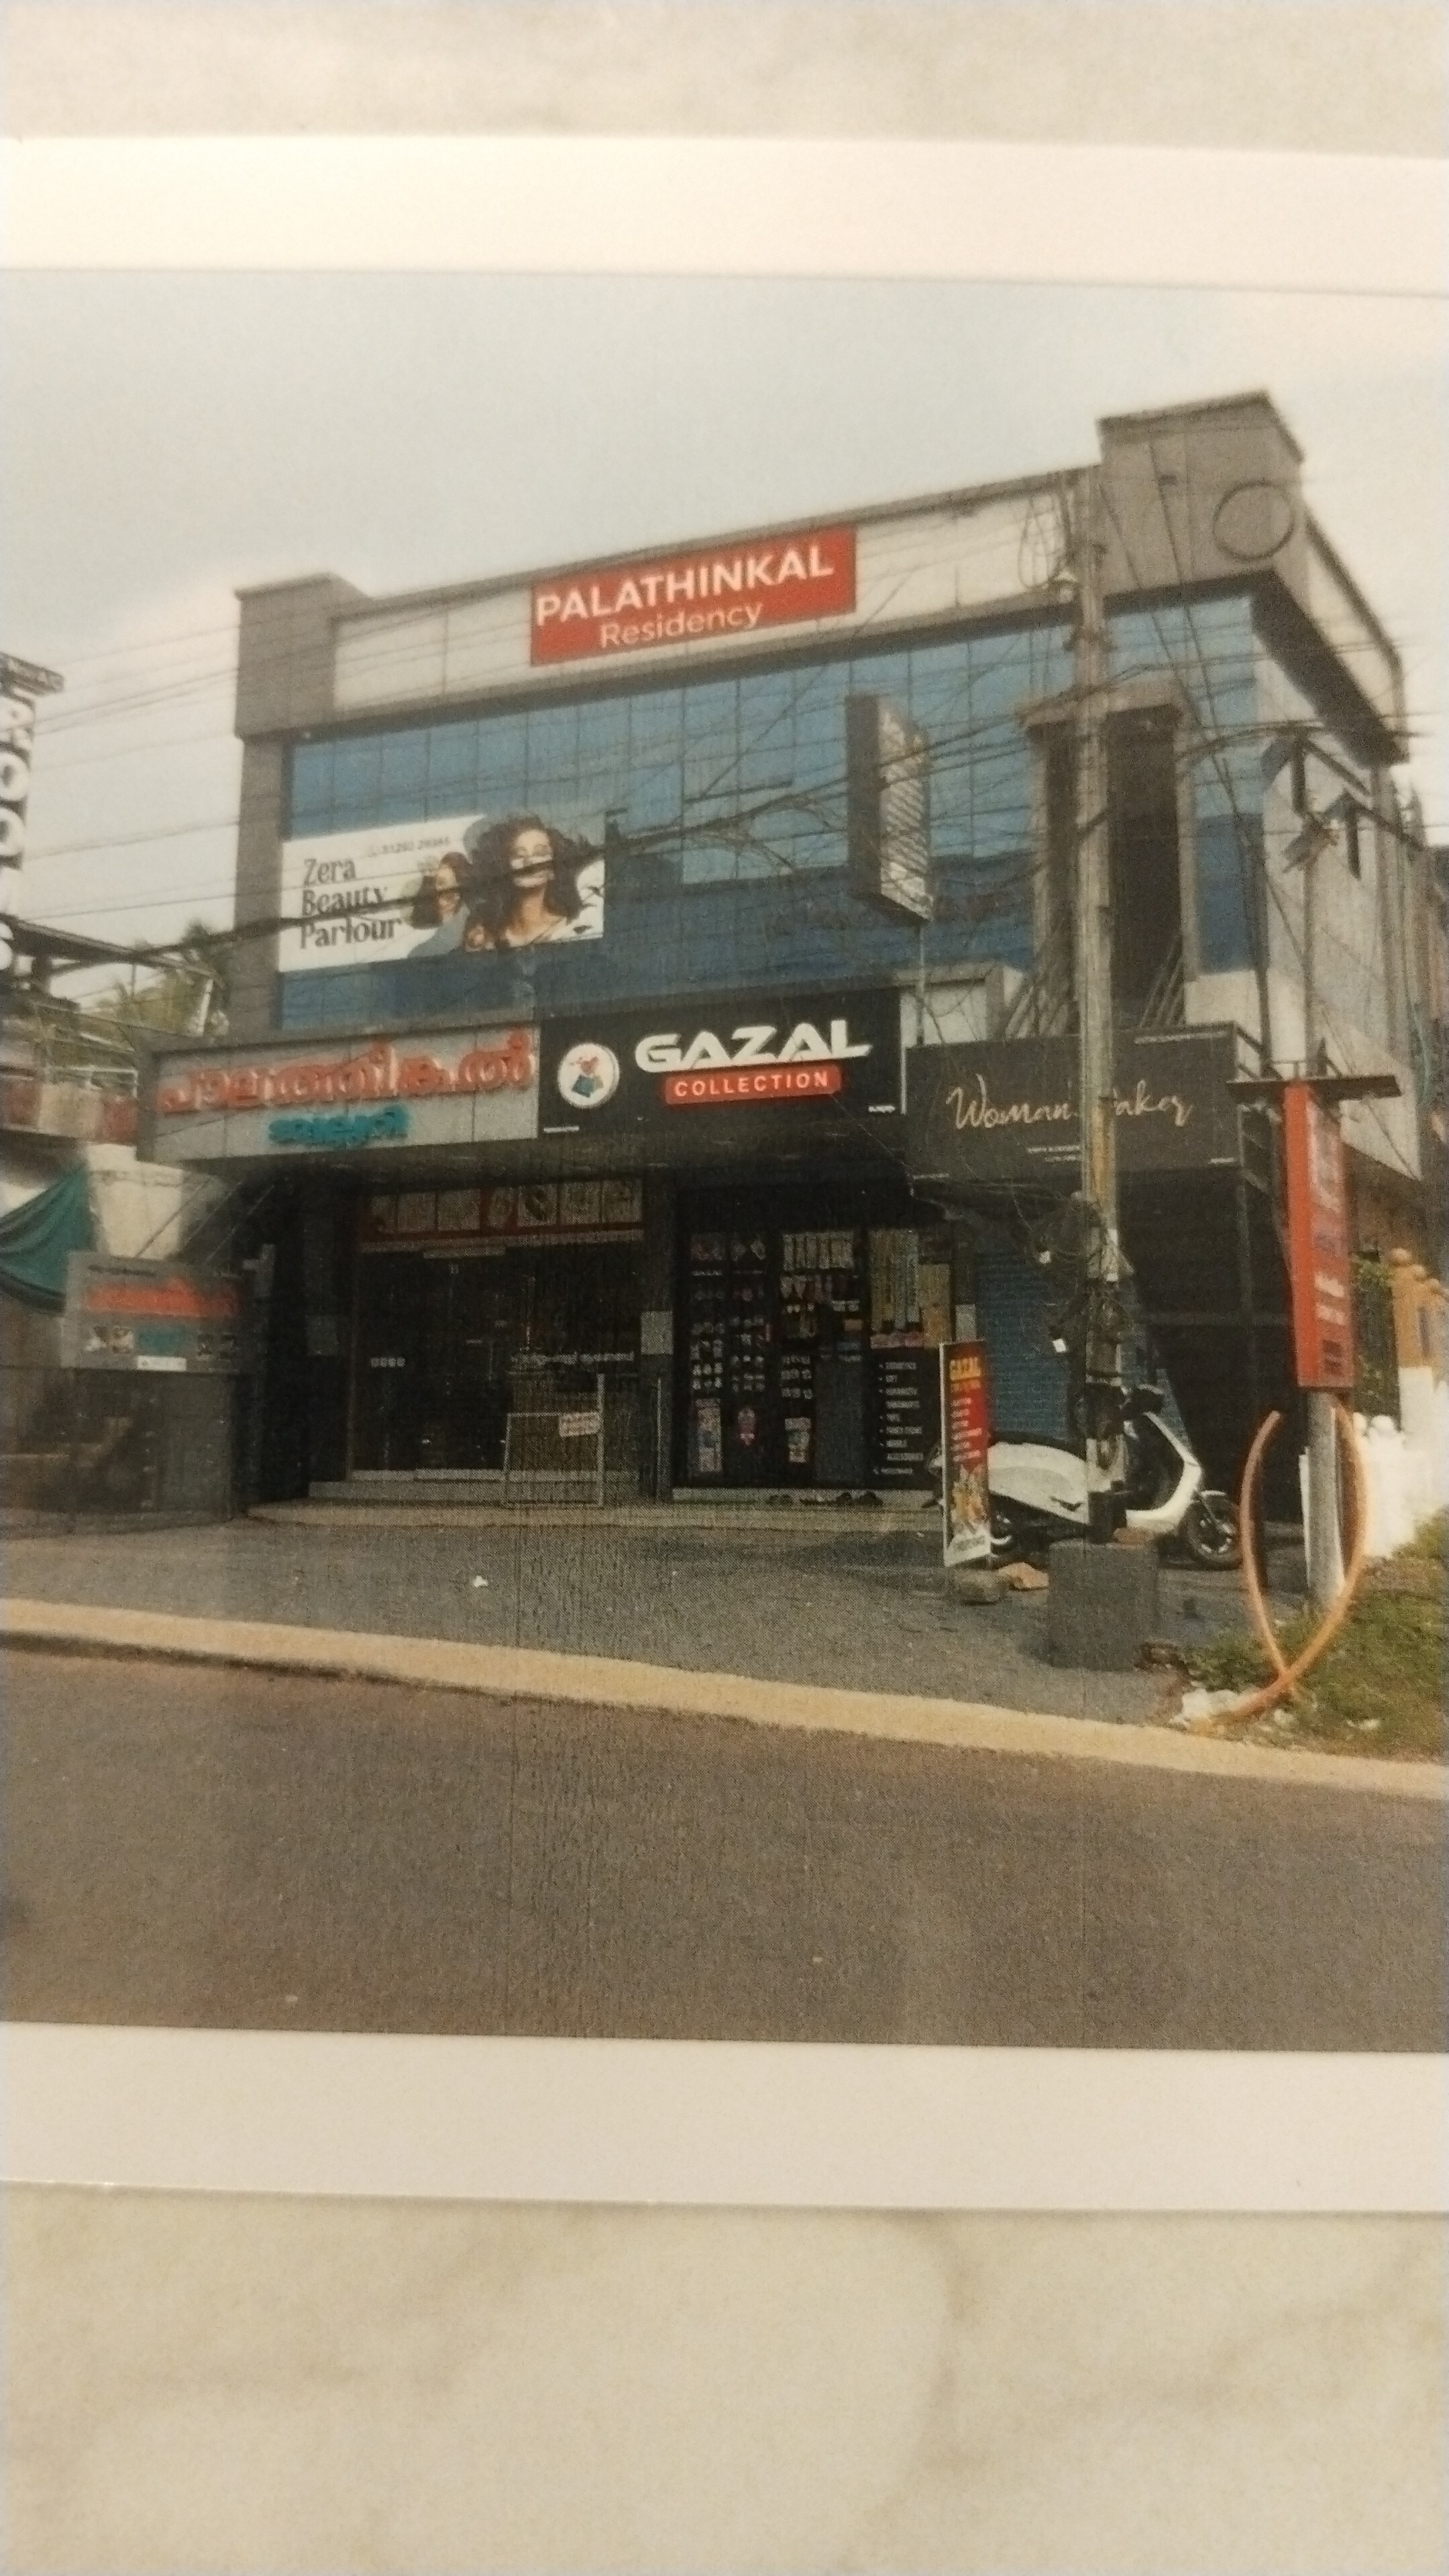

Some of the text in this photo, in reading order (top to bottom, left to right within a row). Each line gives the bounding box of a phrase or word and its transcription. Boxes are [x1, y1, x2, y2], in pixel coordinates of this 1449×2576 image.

[537, 545, 835, 627] PALATHINKAL
[602, 602, 764, 648] Residency
[304, 858, 357, 887] Zera
[303, 887, 387, 916] Beauty
[301, 916, 402, 949] Parlour
[635, 1020, 872, 1073] GAZAL
[674, 1071, 830, 1098] COLLECTION
